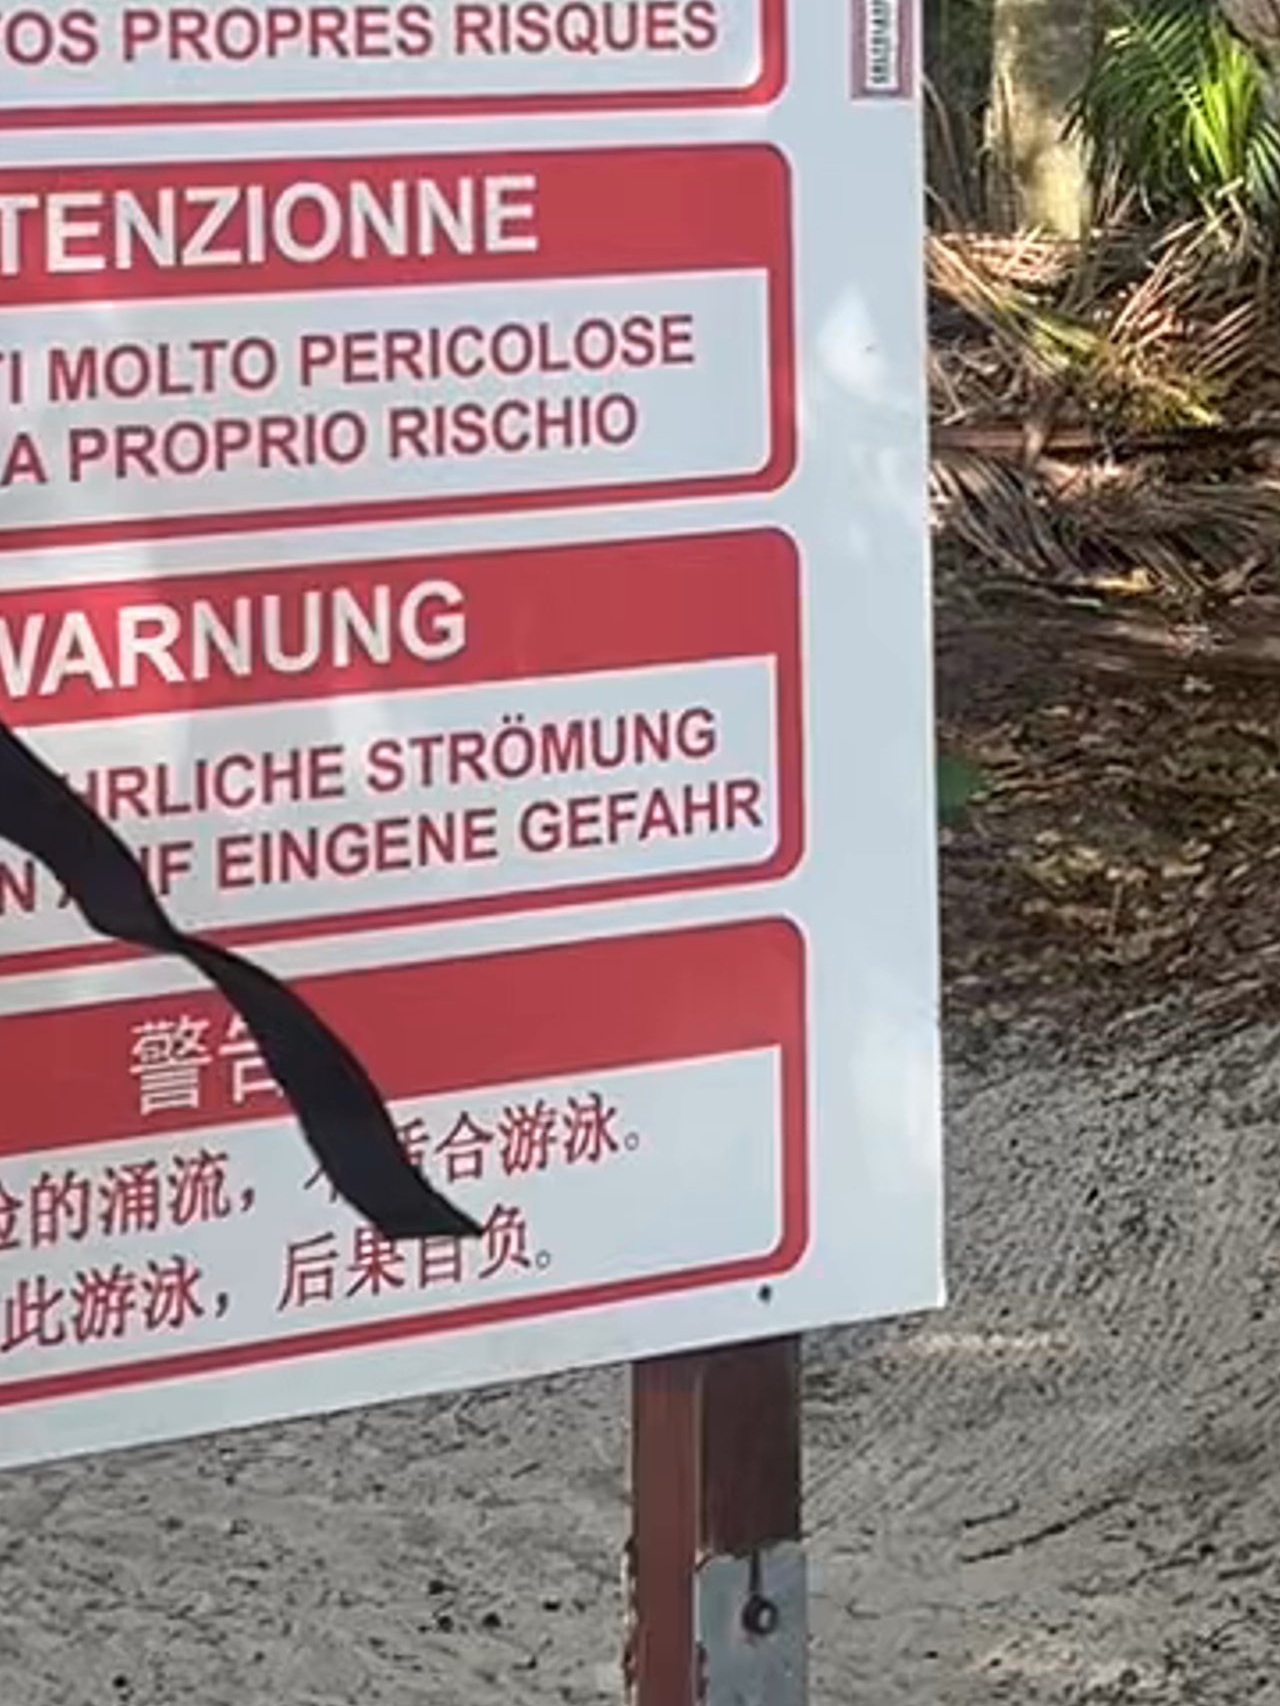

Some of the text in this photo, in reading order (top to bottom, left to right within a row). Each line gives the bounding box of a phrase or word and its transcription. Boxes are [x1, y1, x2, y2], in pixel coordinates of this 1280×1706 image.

[122, 4, 433, 63] PROPRES
[455, 0, 717, 56] RISQUES
[48, 336, 277, 403] MOLTO
[300, 313, 695, 388] PERICOLOSE
[68, 410, 367, 483] PROPRIO
[389, 393, 637, 460] RISCHIO
[367, 707, 716, 793] STRÖMUNG
[216, 807, 499, 890] EINGENE
[519, 778, 763, 854] GEFAHR
[129, 1013, 283, 1116] 警告
